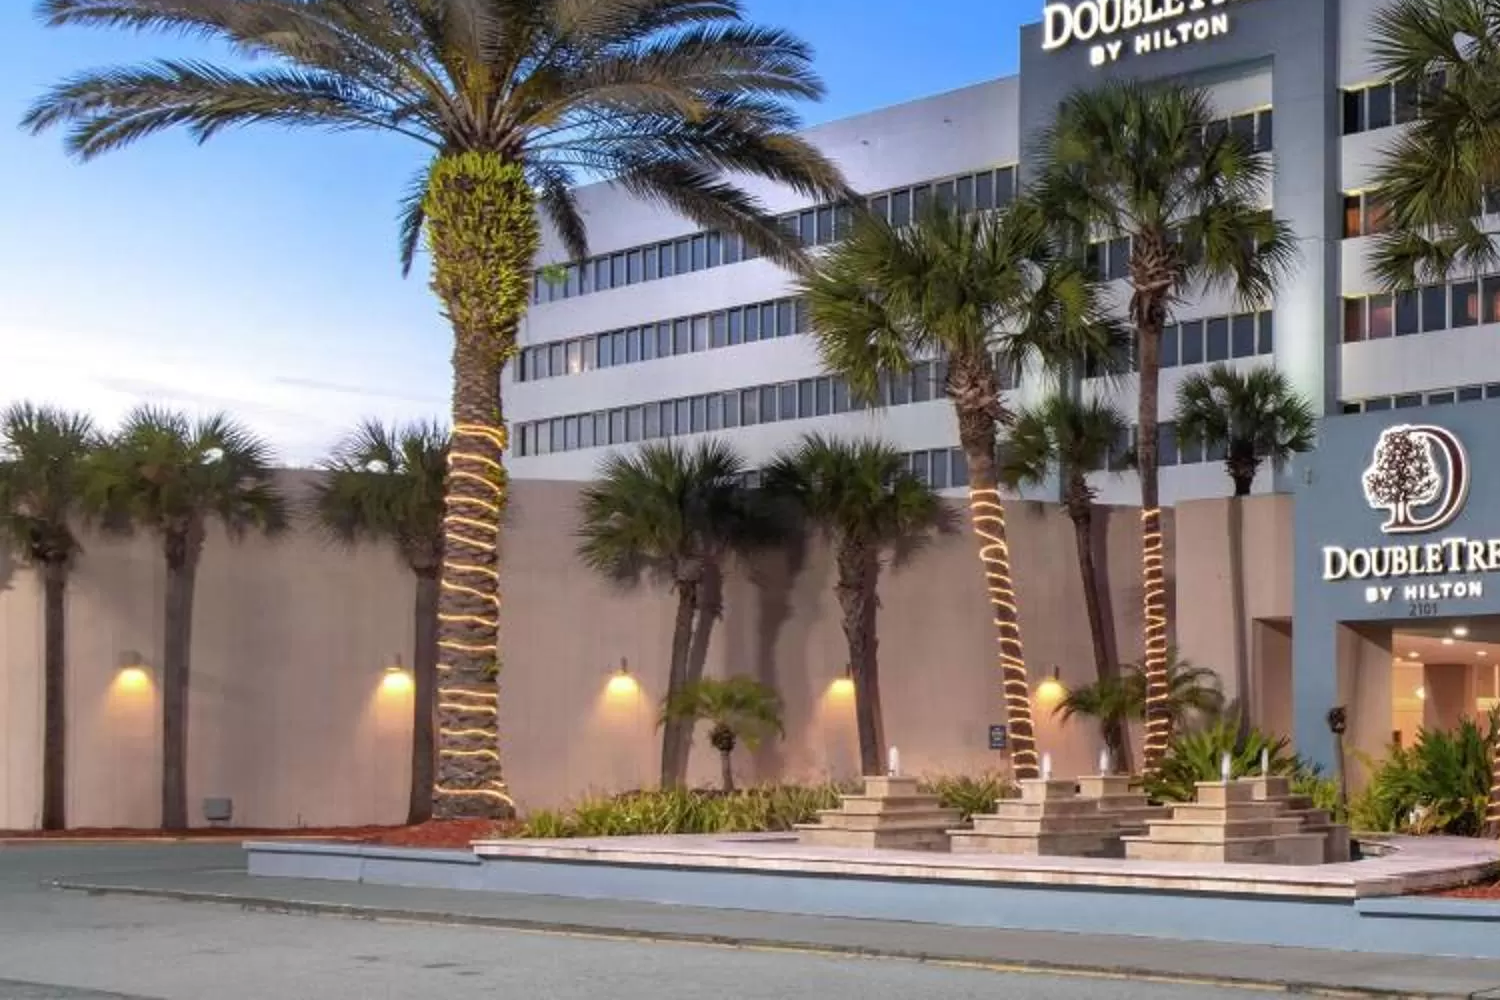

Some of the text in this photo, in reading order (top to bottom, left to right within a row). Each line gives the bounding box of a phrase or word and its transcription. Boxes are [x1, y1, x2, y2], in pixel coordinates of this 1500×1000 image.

[1089, 13, 1229, 67] BY HILTON
[1365, 581, 1483, 603] BY HILTON
[1409, 602, 1438, 617] 2101
